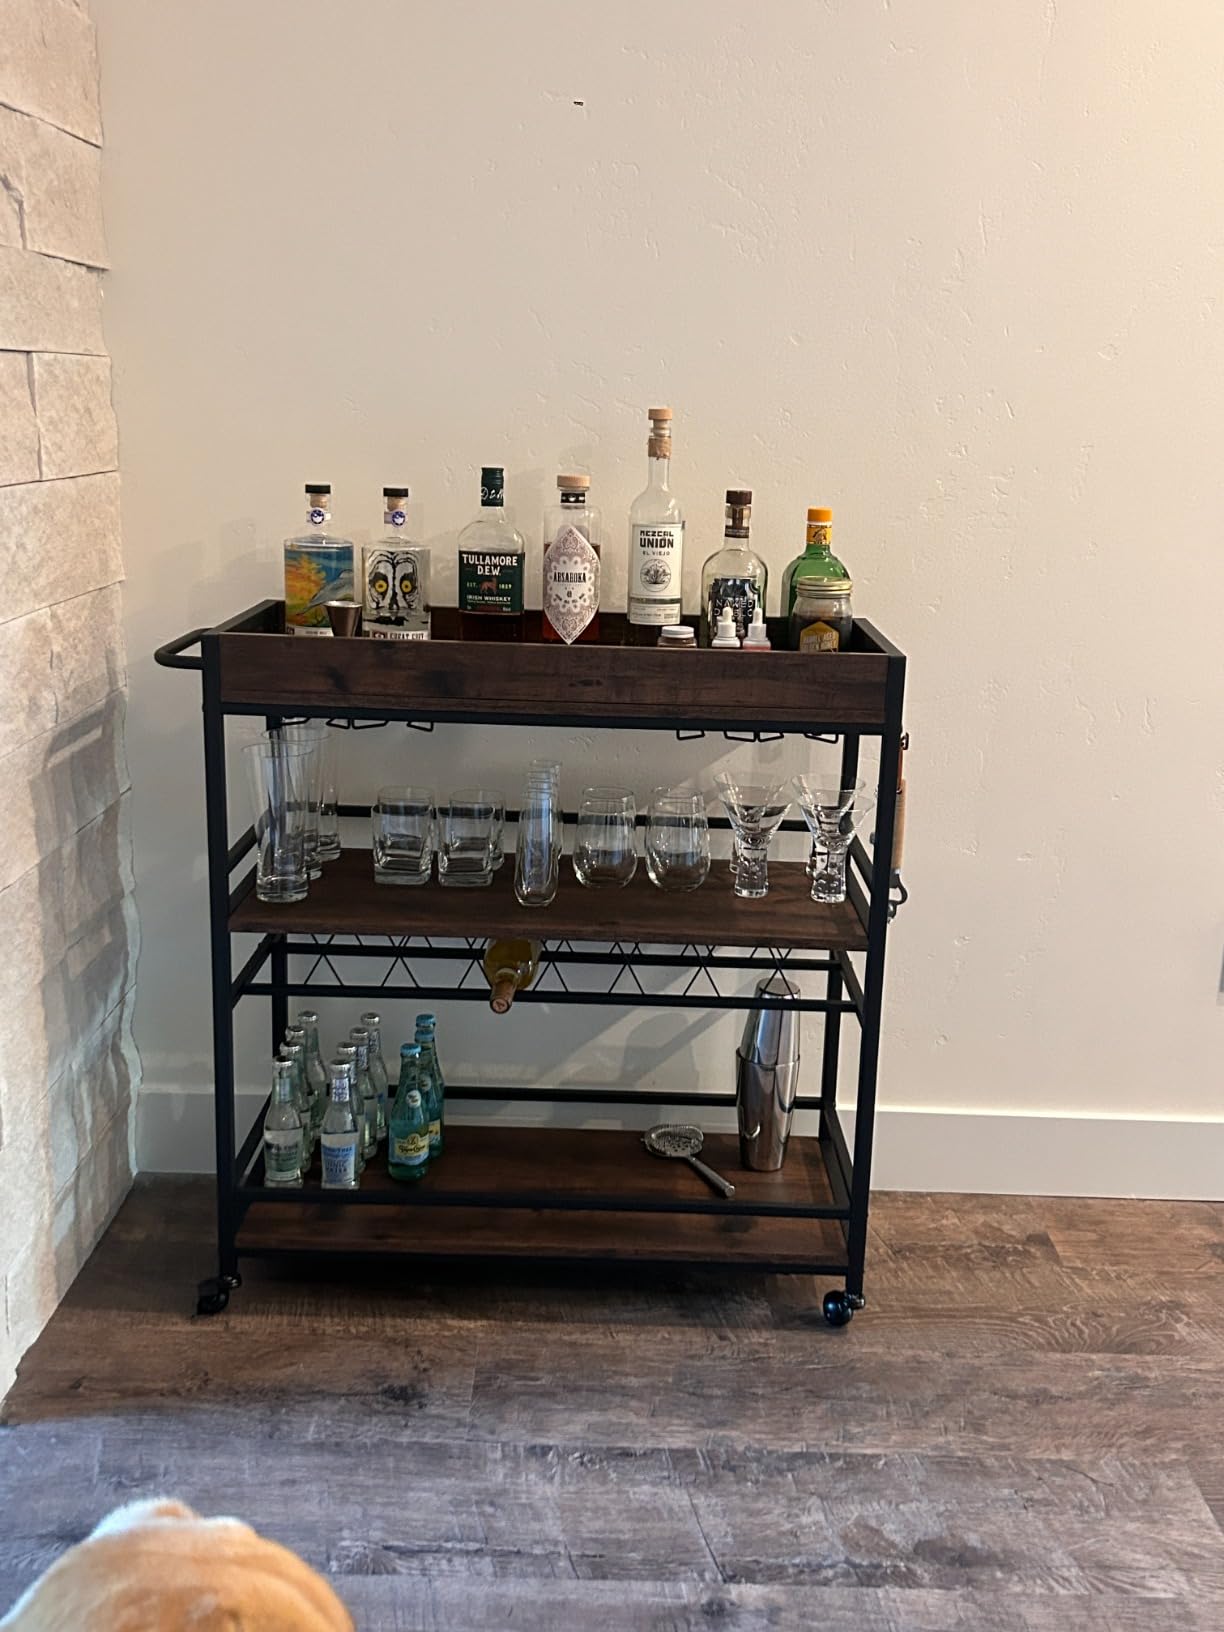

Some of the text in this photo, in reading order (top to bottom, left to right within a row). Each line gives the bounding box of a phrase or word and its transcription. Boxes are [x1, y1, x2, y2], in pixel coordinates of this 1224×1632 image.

[462, 554, 518, 566] TULLAMORE
[716, 599, 754, 608] NAKED
[714, 608, 754, 617] DBLO
